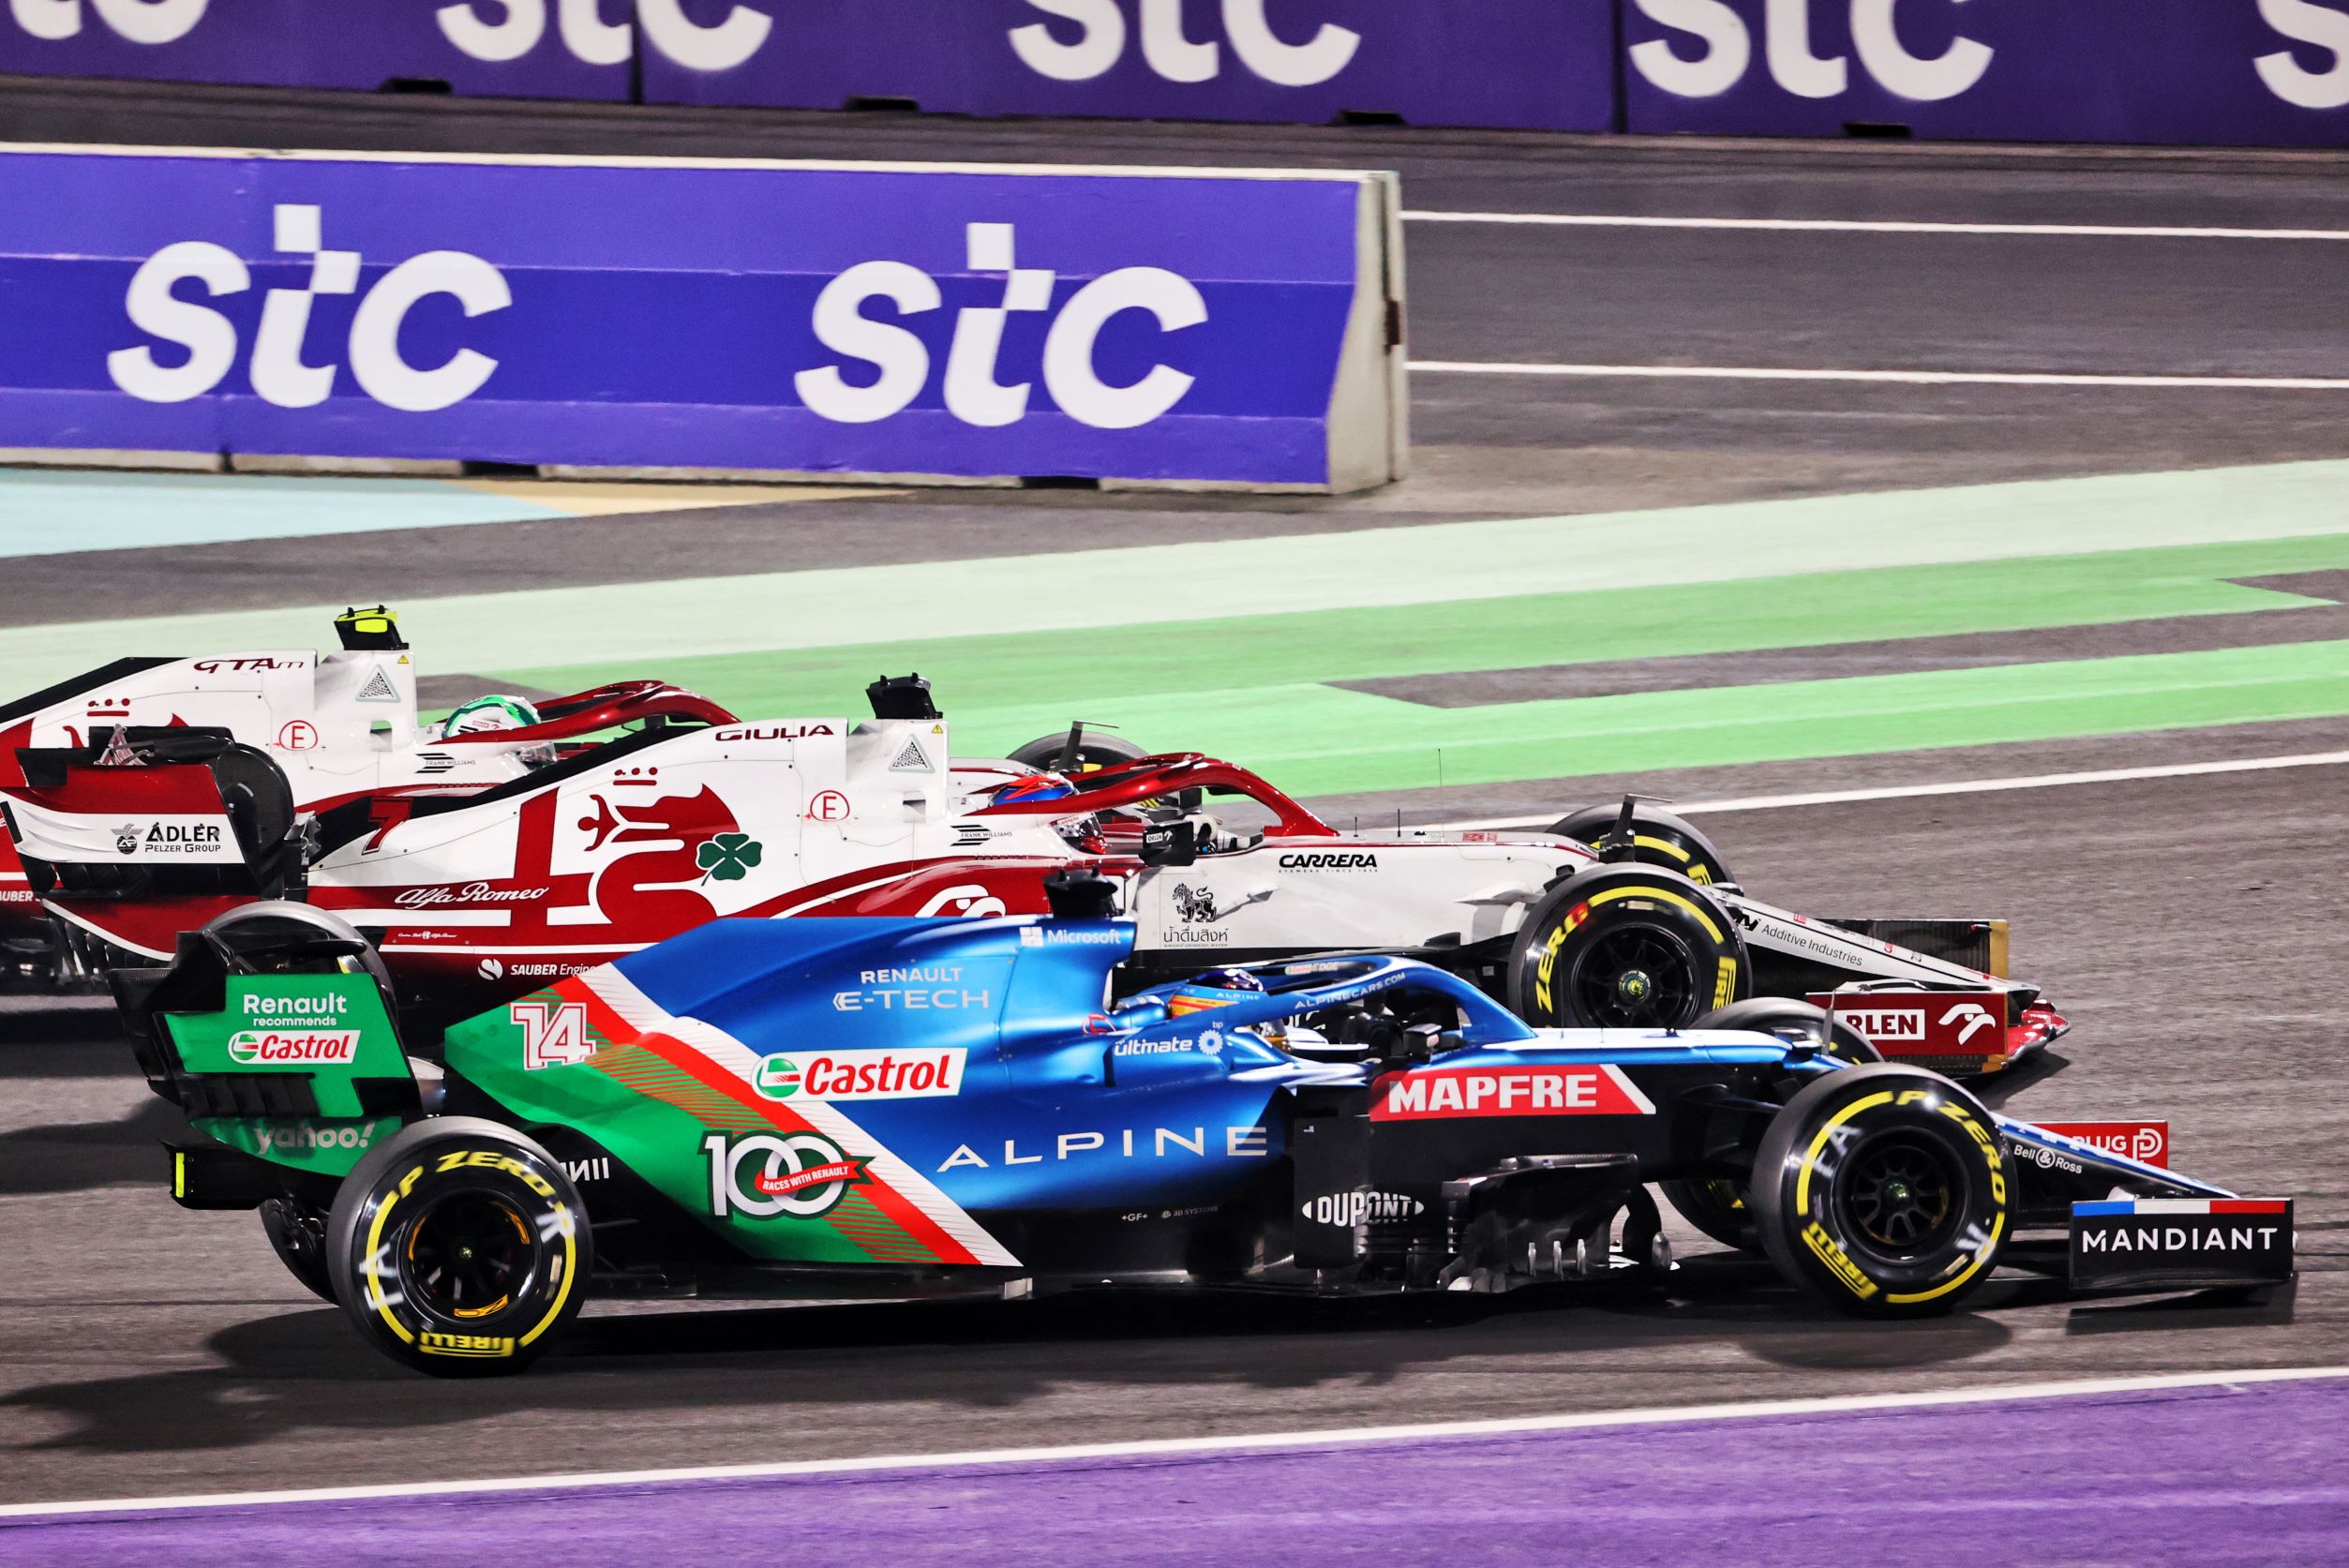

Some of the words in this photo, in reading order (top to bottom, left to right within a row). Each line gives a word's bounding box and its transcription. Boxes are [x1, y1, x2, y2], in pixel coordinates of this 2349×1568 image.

[107, 203, 513, 411] stc
[795, 222, 1209, 430] stc
[292, 724, 307, 749] E
[715, 724, 834, 742] GIULIA
[822, 796, 838, 820] E
[146, 824, 220, 842] ADLER
[361, 797, 414, 857] 7
[145, 844, 182, 853] PELZER
[185, 844, 221, 853] GROUP
[1279, 854, 1378, 868] CARRERA
[456, 881, 549, 902] Romeo
[1047, 929, 1121, 944] Microsoft
[1761, 924, 1807, 948] Additive
[1808, 940, 1863, 966] Industries
[511, 964, 557, 976] SAUBER
[860, 967, 964, 984] RENAULT
[1294, 972, 1406, 1009] ALPINECARS.COM
[1712, 956, 1737, 1011] PIRE
[243, 992, 348, 1015] Renault
[252, 1015, 337, 1027] recommends
[1212, 1021, 1223, 1029] bp
[1847, 1014, 1918, 1035] RLEN
[260, 1034, 350, 1060] Castrol
[510, 1002, 597, 1070] 14
[1114, 1037, 1193, 1056] ultimate
[804, 1053, 952, 1095] Castrol
[1389, 1073, 1597, 1113] MAPFRE
[253, 1121, 375, 1156] yahoo!
[937, 1127, 1267, 1172] ALPINE
[1936, 1100, 2007, 1206] ZERO
[2013, 1144, 2036, 1161] Bell
[2055, 1158, 2083, 1174] Ross
[436, 1151, 557, 1198] ZERO
[704, 1135, 846, 1217] 100
[762, 1179, 791, 1191] RACES
[789, 1173, 812, 1187] WITH
[812, 1166, 849, 1181] RENAULT
[1317, 1191, 1413, 1228] DUPONT
[2082, 1227, 2279, 1253] MANDIANT
